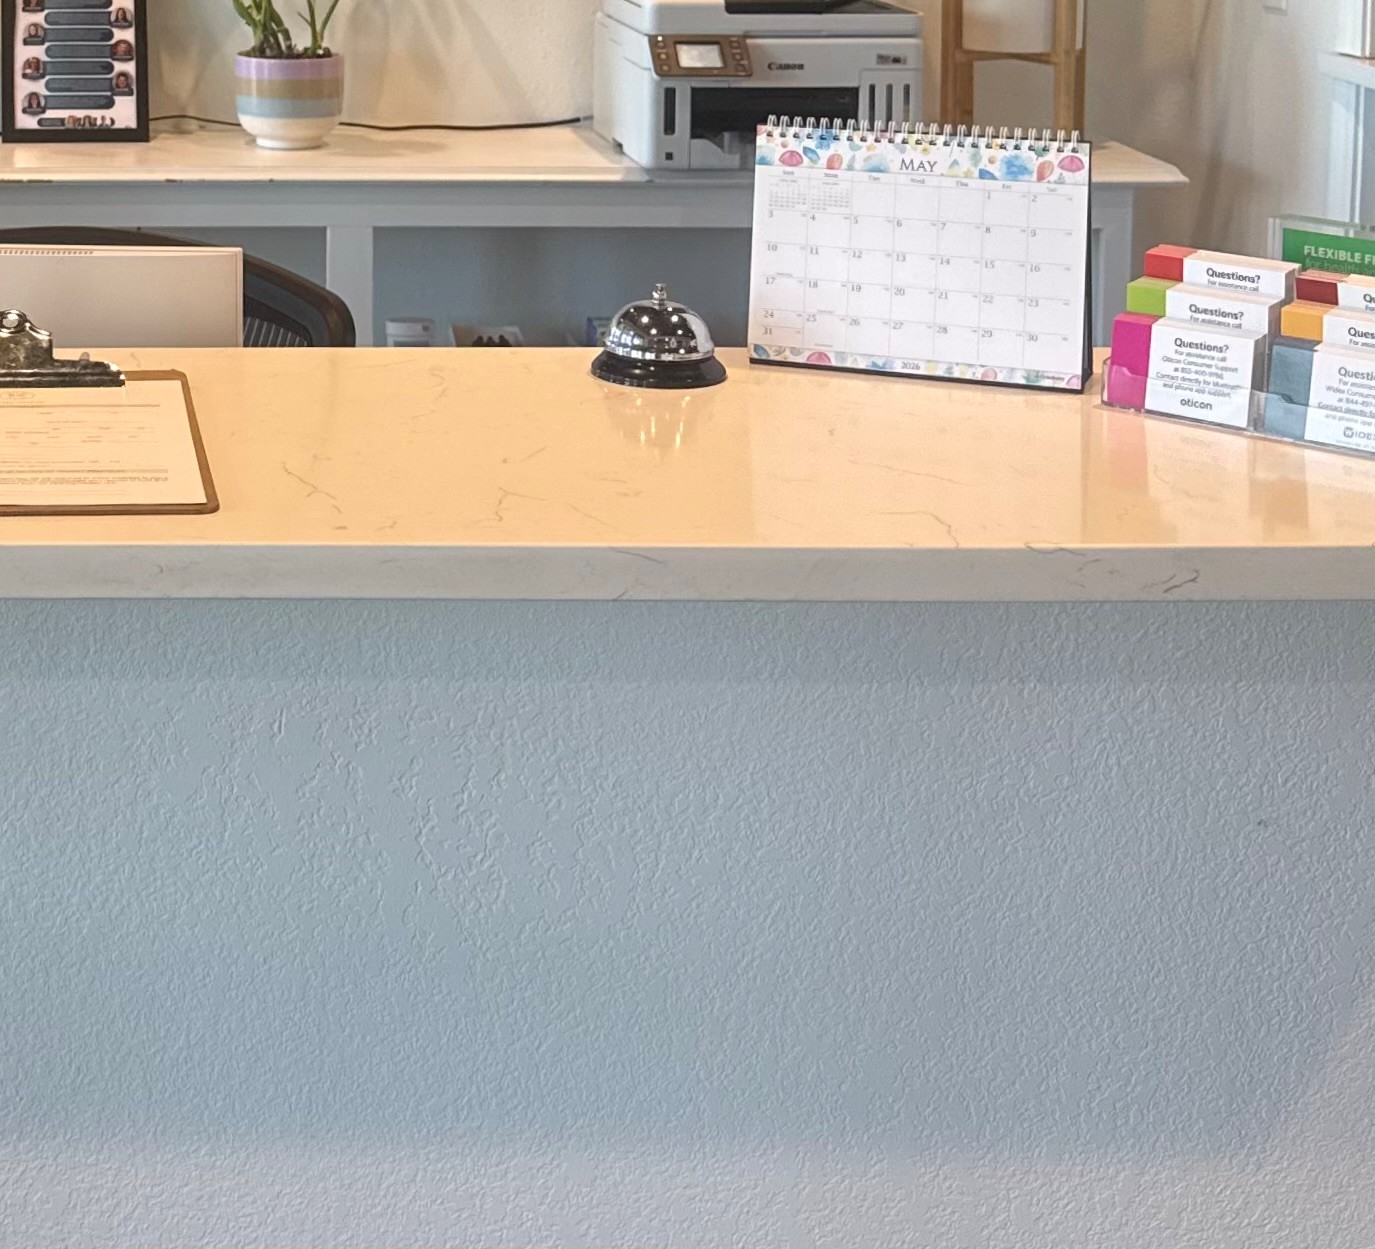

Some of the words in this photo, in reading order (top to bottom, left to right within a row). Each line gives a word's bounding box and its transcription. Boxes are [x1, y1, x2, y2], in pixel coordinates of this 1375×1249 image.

[899, 157, 938, 173] MAY
[896, 220, 903, 228] 6
[940, 222, 946, 231] 7
[985, 226, 991, 234] 8
[1030, 229, 1037, 238] 9
[1304, 245, 1362, 263] FLEXIBLE
[1206, 267, 1261, 284] Questions?
[1207, 279, 1217, 287] For
[1218, 281, 1248, 291] assistance
[1189, 303, 1244, 321] Questions?
[1189, 315, 1199, 323] For
[1232, 322, 1242, 330] call
[1174, 337, 1229, 354] Questions?
[1349, 339, 1359, 347] For
[900, 360, 921, 371] 2026
[1338, 378, 1349, 386] For
[1179, 398, 1213, 411] oticon
